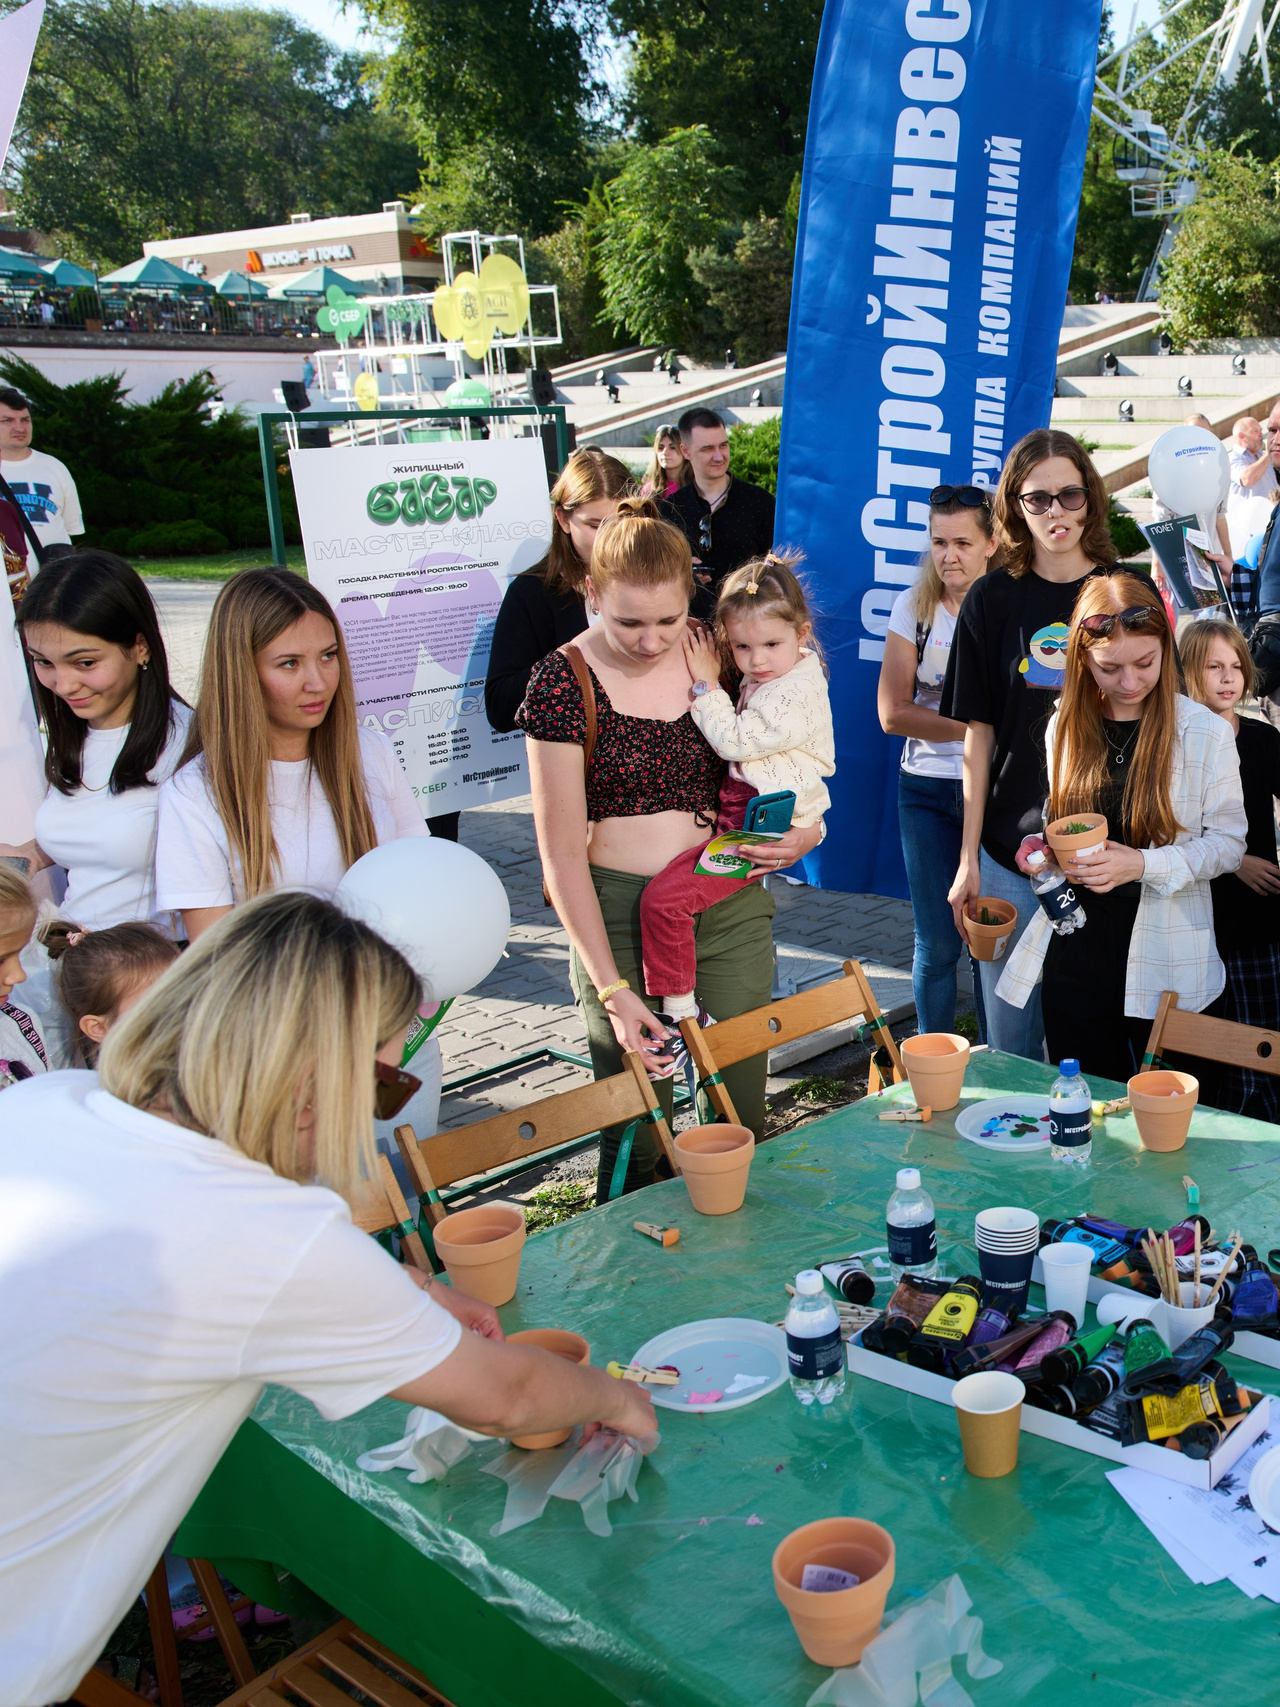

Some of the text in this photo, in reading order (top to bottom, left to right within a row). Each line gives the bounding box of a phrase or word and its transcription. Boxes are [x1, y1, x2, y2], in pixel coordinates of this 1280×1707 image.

[340, 309, 360, 322] СБЕР
[972, 135, 1022, 486] РУППА КОМПАНИЙ
[859, 0, 972, 662] ЮгСтройИнвес
[392, 462, 464, 474] ЖИЛИЩНЫЙ
[14, 494, 58, 516] INGTON
[313, 519, 548, 561] МАСТЕР-КЛАСС
[338, 574, 378, 585] ПОСАДКА
[379, 570, 420, 580] РАСТЕНИЙ
[427, 565, 463, 574] РОСПИСЬ
[464, 561, 499, 570] ГОРШКОВ
[341, 595, 368, 603] ВРЕМЯ
[370, 588, 423, 600] ПРОВЕДЕНИЯ:
[448, 582, 468, 590] 19:00
[409, 610, 442, 618] мастер-класс
[470, 601, 492, 610] растений
[351, 632, 370, 640] начале
[370, 628, 408, 638] мастер-класса
[409, 623, 434, 632] участники
[435, 620, 458, 629] получают
[459, 617, 478, 625] горшки
[356, 622, 394, 633] увлекательное
[417, 616, 437, 624] которое
[439, 612, 467, 621] объединяет
[468, 608, 494, 617] творчество
[391, 634, 414, 642] саженцы
[454, 625, 474, 633] посадки.
[396, 638, 430, 649] расписывают
[454, 630, 484, 639] высаживают
[380, 648, 415, 657] рассказывает
[428, 641, 457, 651] правильных
[458, 638, 476, 646] методах
[356, 659, 387, 669] растениями
[419, 650, 447, 659] пригодится
[359, 667, 387, 675] окончании
[387, 660, 426, 671] мастер-класса,
[427, 656, 446, 664] каждый
[447, 653, 468, 661] участник
[354, 676, 371, 684] оршок
[375, 672, 397, 681] цветами
[397, 668, 416, 676] домой.
[366, 694, 401, 706] УЧАСТИЕ
[402, 690, 427, 699] ГОСТИ
[427, 682, 469, 695] ПОЛУЧАЮТ
[469, 679, 485, 688] 200
[357, 695, 487, 733] АСПИС
[427, 728, 467, 740] 14:40 15:10
[428, 735, 470, 749] 15:20 15:50
[429, 744, 471, 757] 16:00 16:30
[429, 752, 469, 766] 16:40 17:10
[462, 763, 521, 784] ЮгСтройИнвест
[422, 782, 447, 795] СБЕР
[9, 1009, 33, 1034] SHINE
[26, 1030, 45, 1056] SHINE
[1064, 1121, 1092, 1134] ЮГСТРОЙ
[985, 1279, 1027, 1290] ЮГСТРОЙИНВЕСТ
